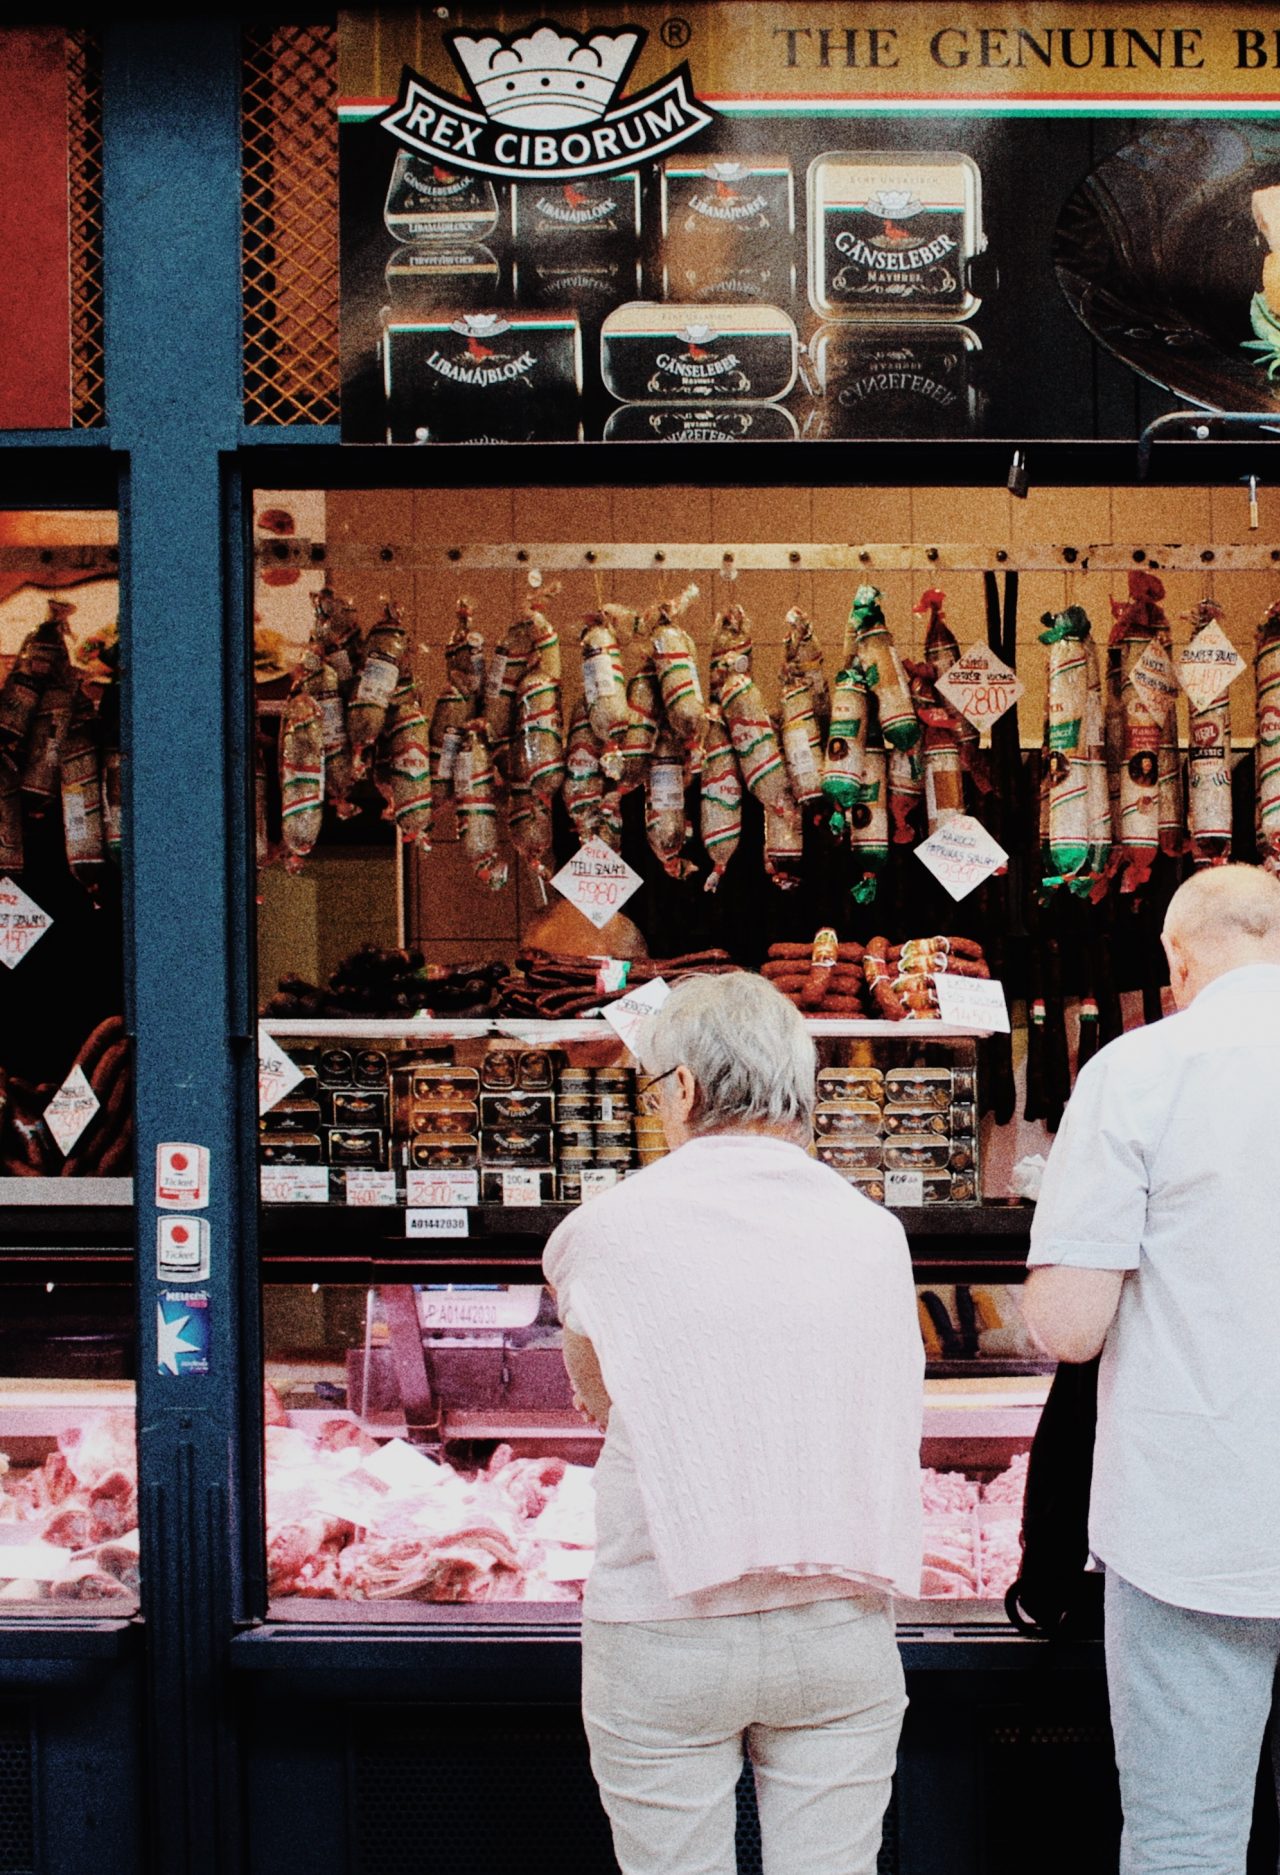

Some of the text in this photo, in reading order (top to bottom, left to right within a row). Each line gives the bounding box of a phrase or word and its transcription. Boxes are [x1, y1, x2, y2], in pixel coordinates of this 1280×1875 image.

[773, 28, 900, 68] THE
[929, 28, 1204, 69] GENUINE
[405, 98, 686, 166] REX CIBORUM
[834, 231, 957, 272] GÄNSELEBER
[426, 350, 538, 387] LIBAMÁJBLOKK
[655, 352, 741, 378] GÄNSELEBER
